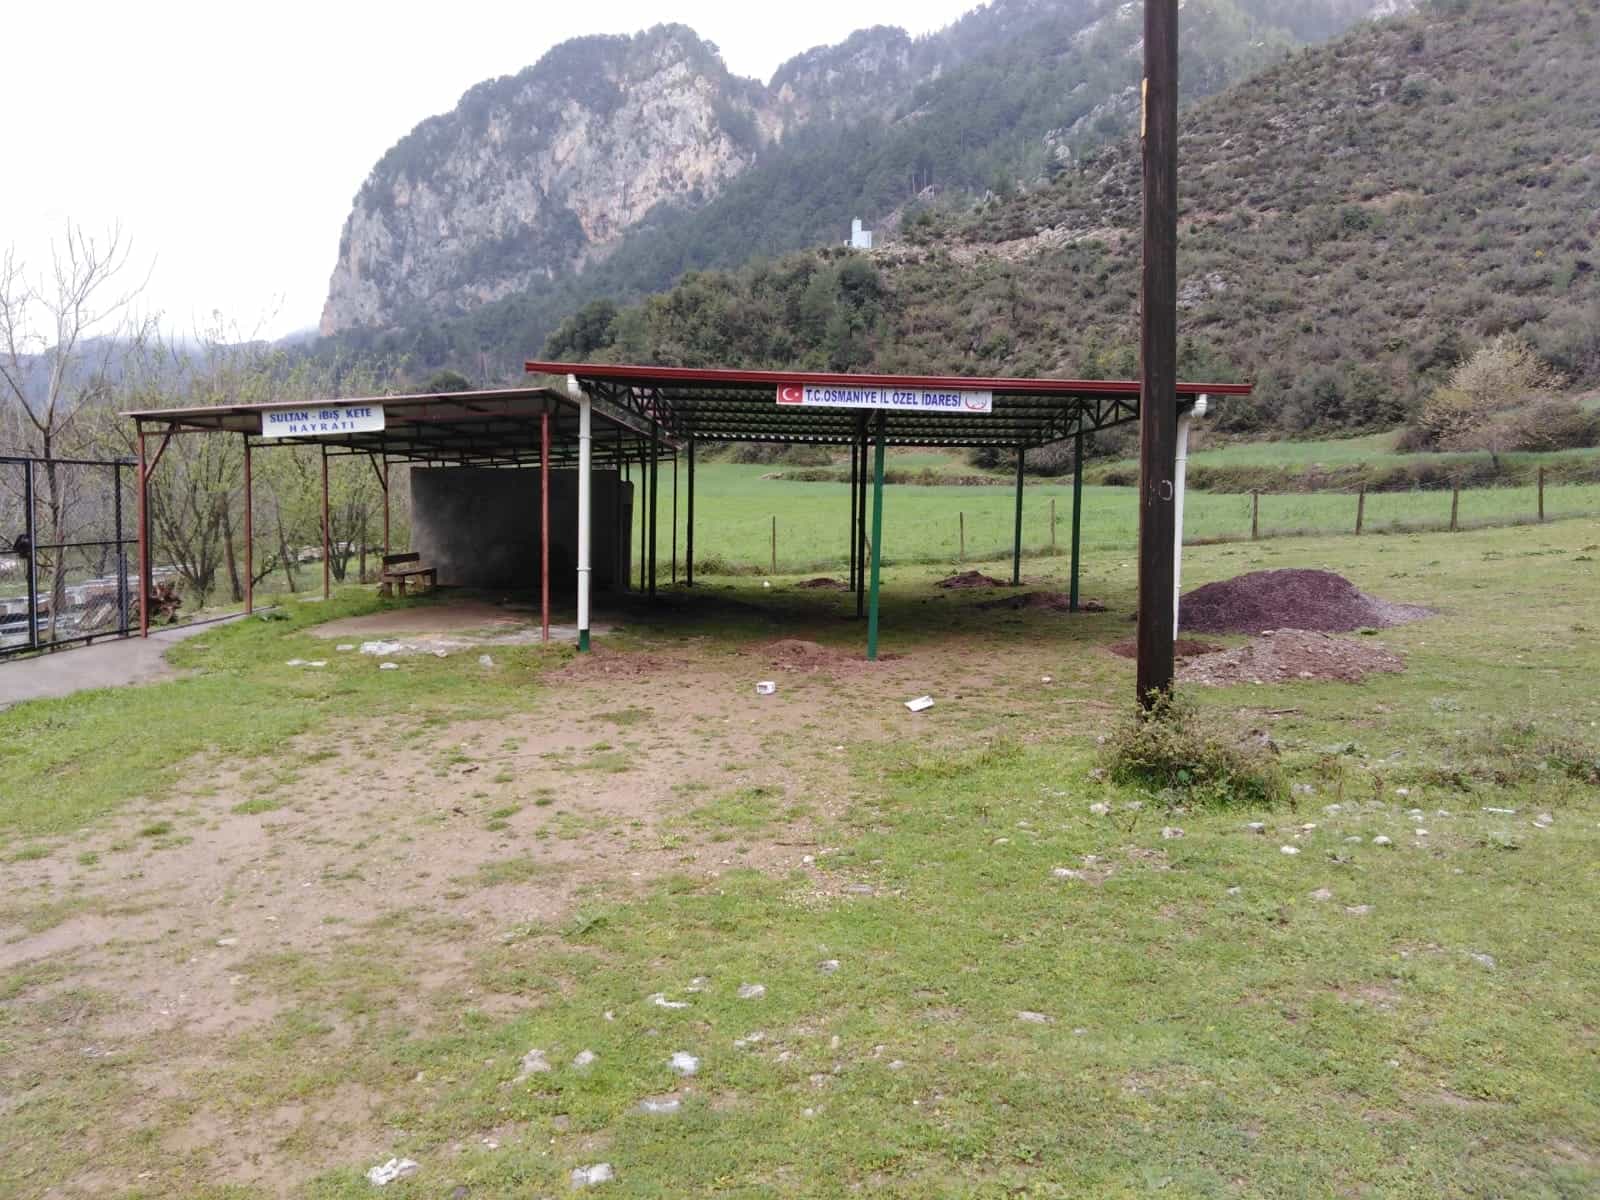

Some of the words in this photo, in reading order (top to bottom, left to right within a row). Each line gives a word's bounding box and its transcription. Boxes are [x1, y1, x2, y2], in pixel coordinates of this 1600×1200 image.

[921, 389, 961, 407] İDARESİ
[270, 411, 309, 423] SULTAN
[345, 408, 372, 418] KETE
[289, 421, 355, 433] HAYRATI
